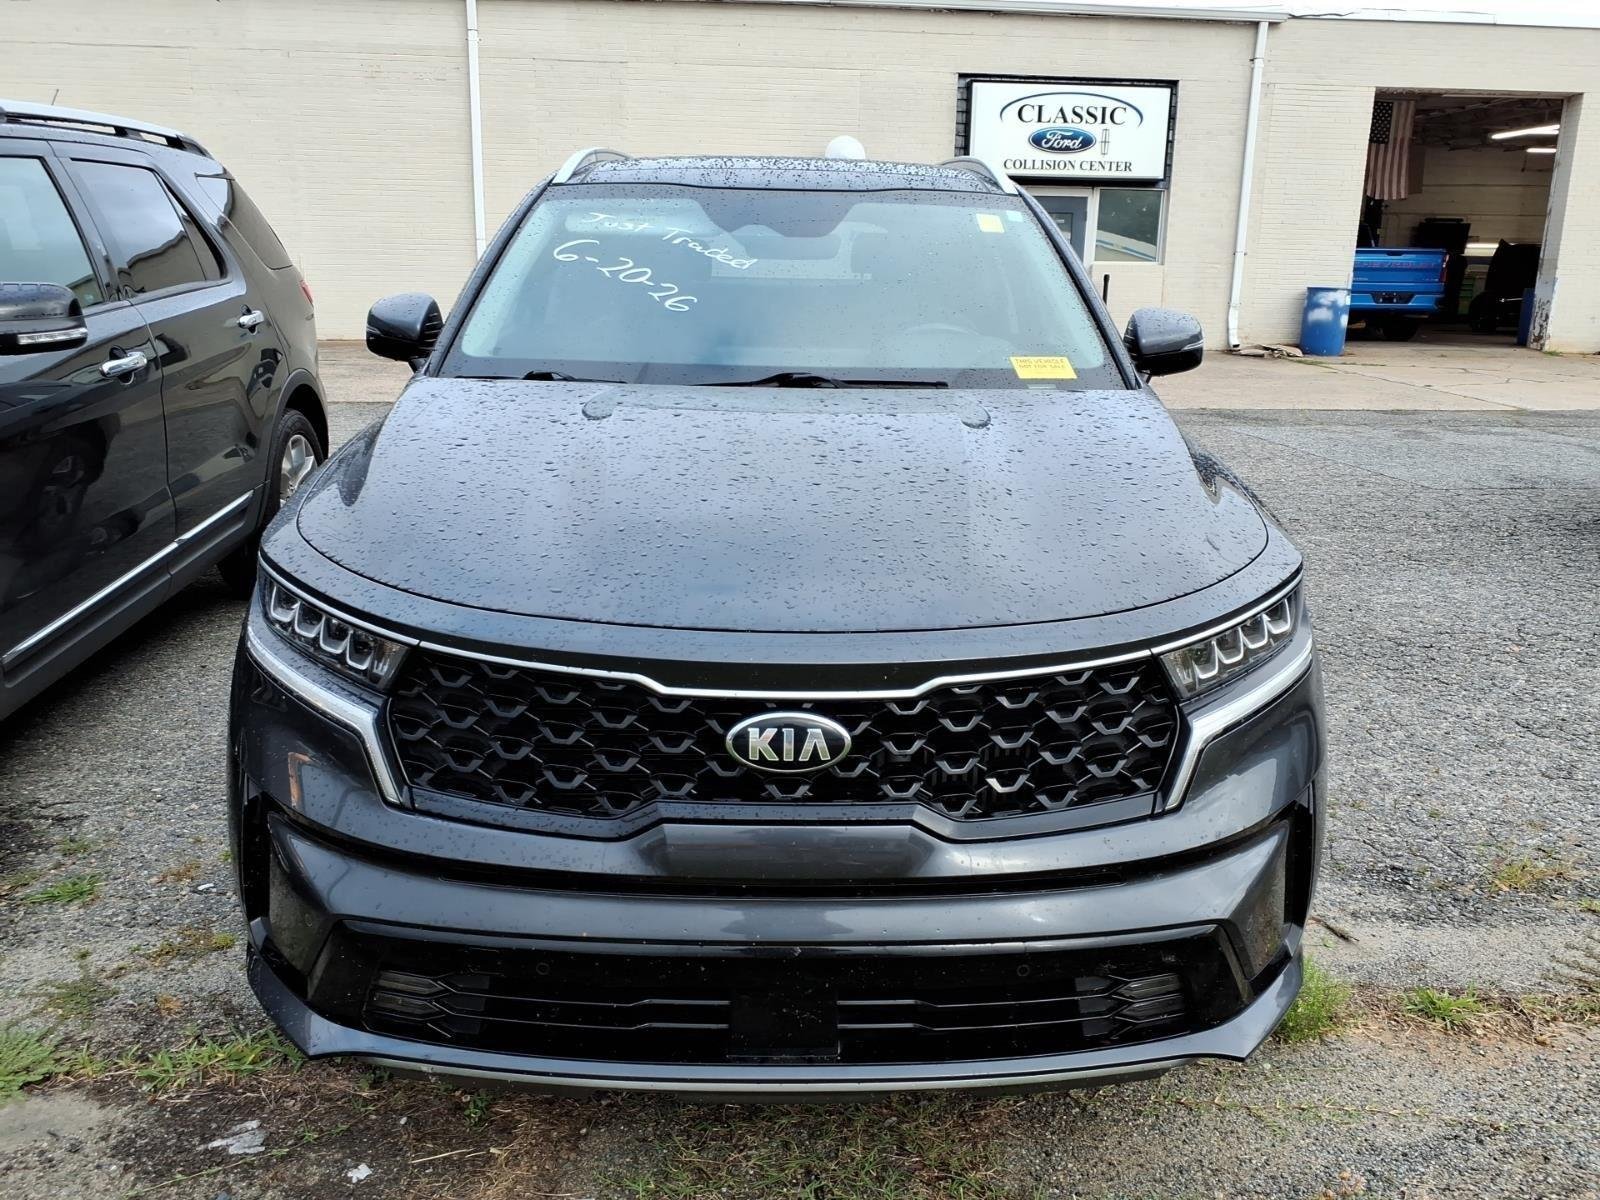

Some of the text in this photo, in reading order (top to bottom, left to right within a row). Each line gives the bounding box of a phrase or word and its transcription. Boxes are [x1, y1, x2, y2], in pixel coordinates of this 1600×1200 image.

[1017, 103, 1127, 126] CLASSIC
[1041, 130, 1082, 150] Ford
[1003, 158, 1133, 172] COLLISION CENTER
[582, 212, 758, 270] Just Traded
[553, 239, 698, 312] 6-20-26
[747, 727, 831, 762] KIA
